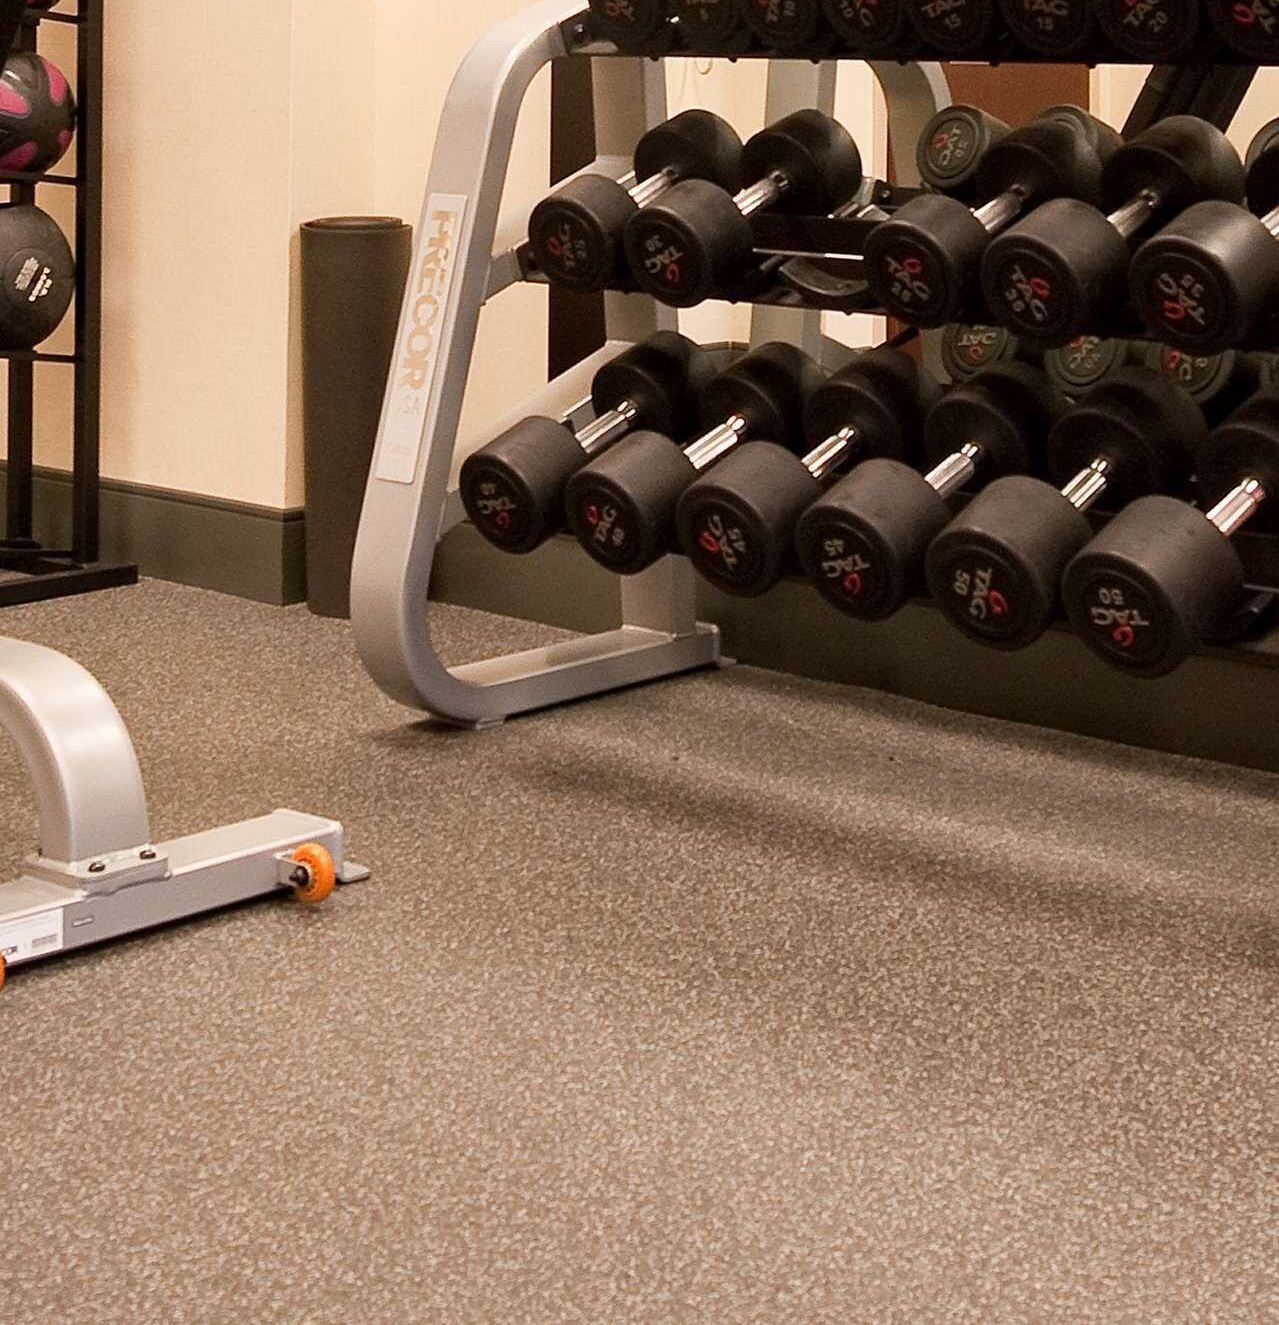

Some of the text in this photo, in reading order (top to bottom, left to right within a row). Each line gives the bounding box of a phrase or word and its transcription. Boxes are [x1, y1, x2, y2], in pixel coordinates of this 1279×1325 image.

[943, 12, 962, 30] 15
[1035, 16, 1055, 32] 15
[1147, 9, 1168, 34] 20
[644, 244, 686, 275] TAG
[884, 256, 933, 302] TAG
[1012, 263, 1050, 323] TAG
[399, 210, 457, 390] PRECOR
[1157, 272, 1207, 326] TAG
[593, 505, 619, 544] TAG
[707, 514, 739, 571] TAG
[823, 538, 845, 558] 45
[820, 553, 872, 580] TAG
[953, 568, 972, 597] 50
[967, 567, 993, 622] TAG
[1097, 586, 1126, 606] 50
[1089, 606, 1151, 627] TAG
